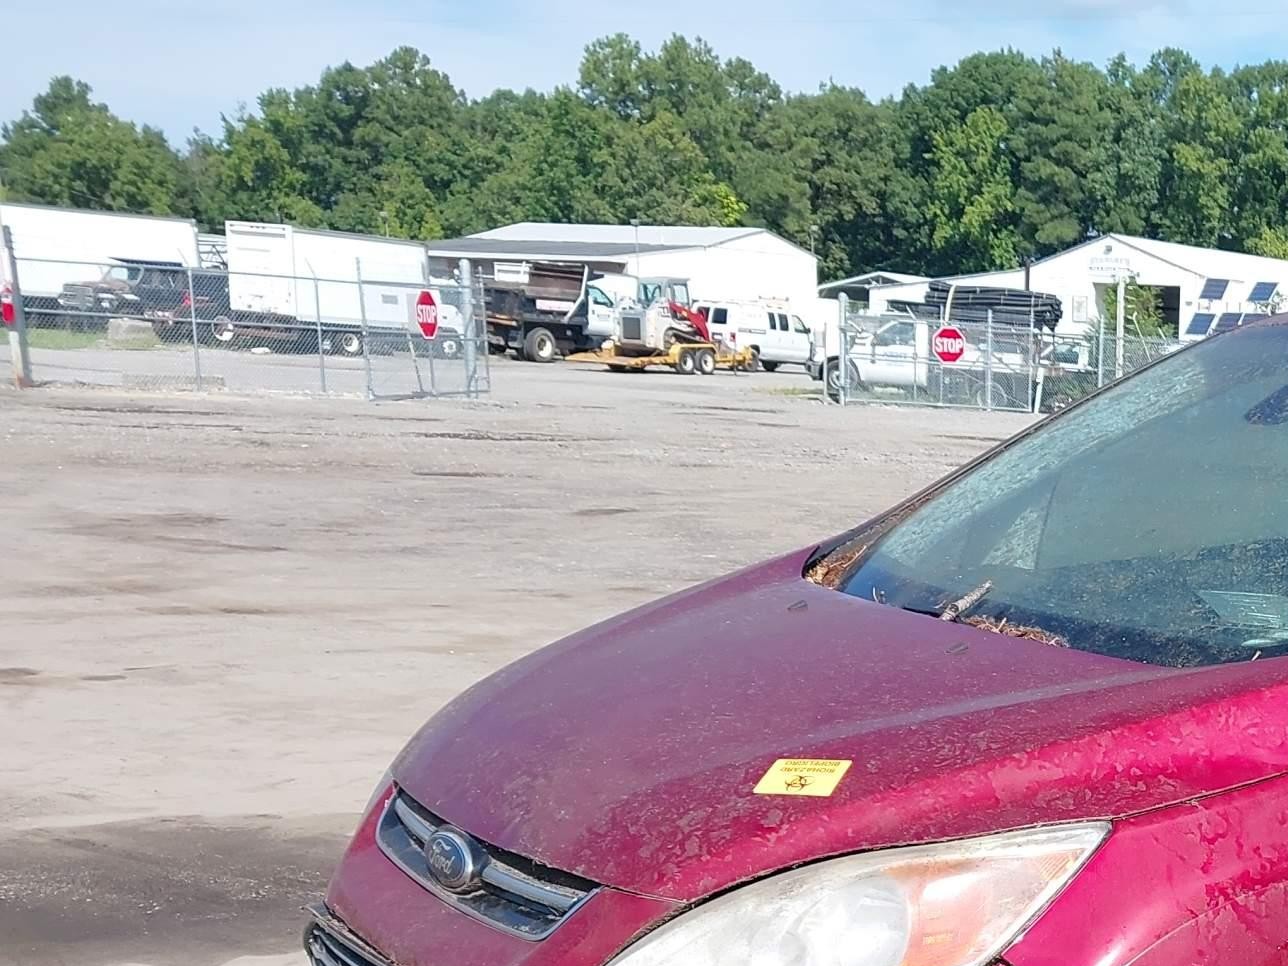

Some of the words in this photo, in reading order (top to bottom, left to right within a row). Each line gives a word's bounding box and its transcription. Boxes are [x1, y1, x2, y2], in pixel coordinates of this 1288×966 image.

[416, 304, 437, 324] STOP
[935, 336, 964, 354] STOP
[430, 838, 456, 875] Ford
